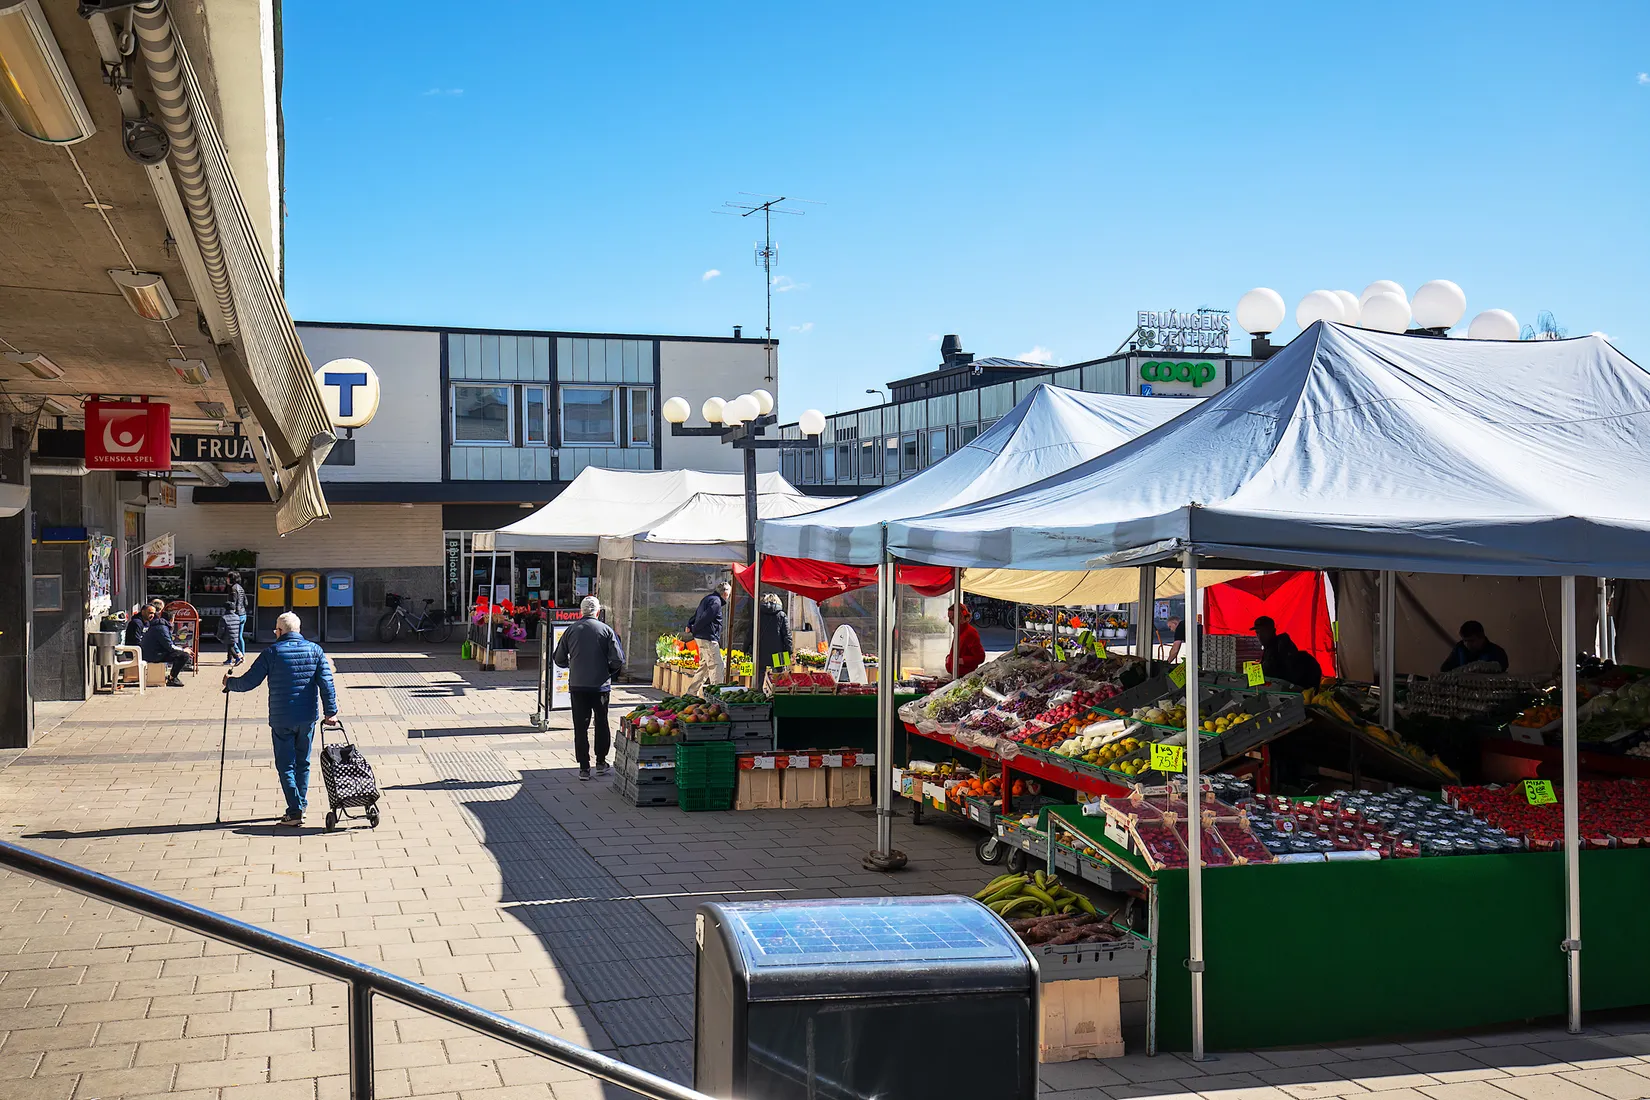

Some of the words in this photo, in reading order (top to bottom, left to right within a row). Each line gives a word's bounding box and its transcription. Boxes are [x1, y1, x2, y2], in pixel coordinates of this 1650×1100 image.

[1158, 330, 1229, 349] CENTRUM
[1140, 361, 1216, 388] coop
[324, 372, 367, 417] T
[94, 455, 132, 463] SVENSKA
[449, 541, 459, 584] Bibliotek
[555, 609, 600, 621] Hem
